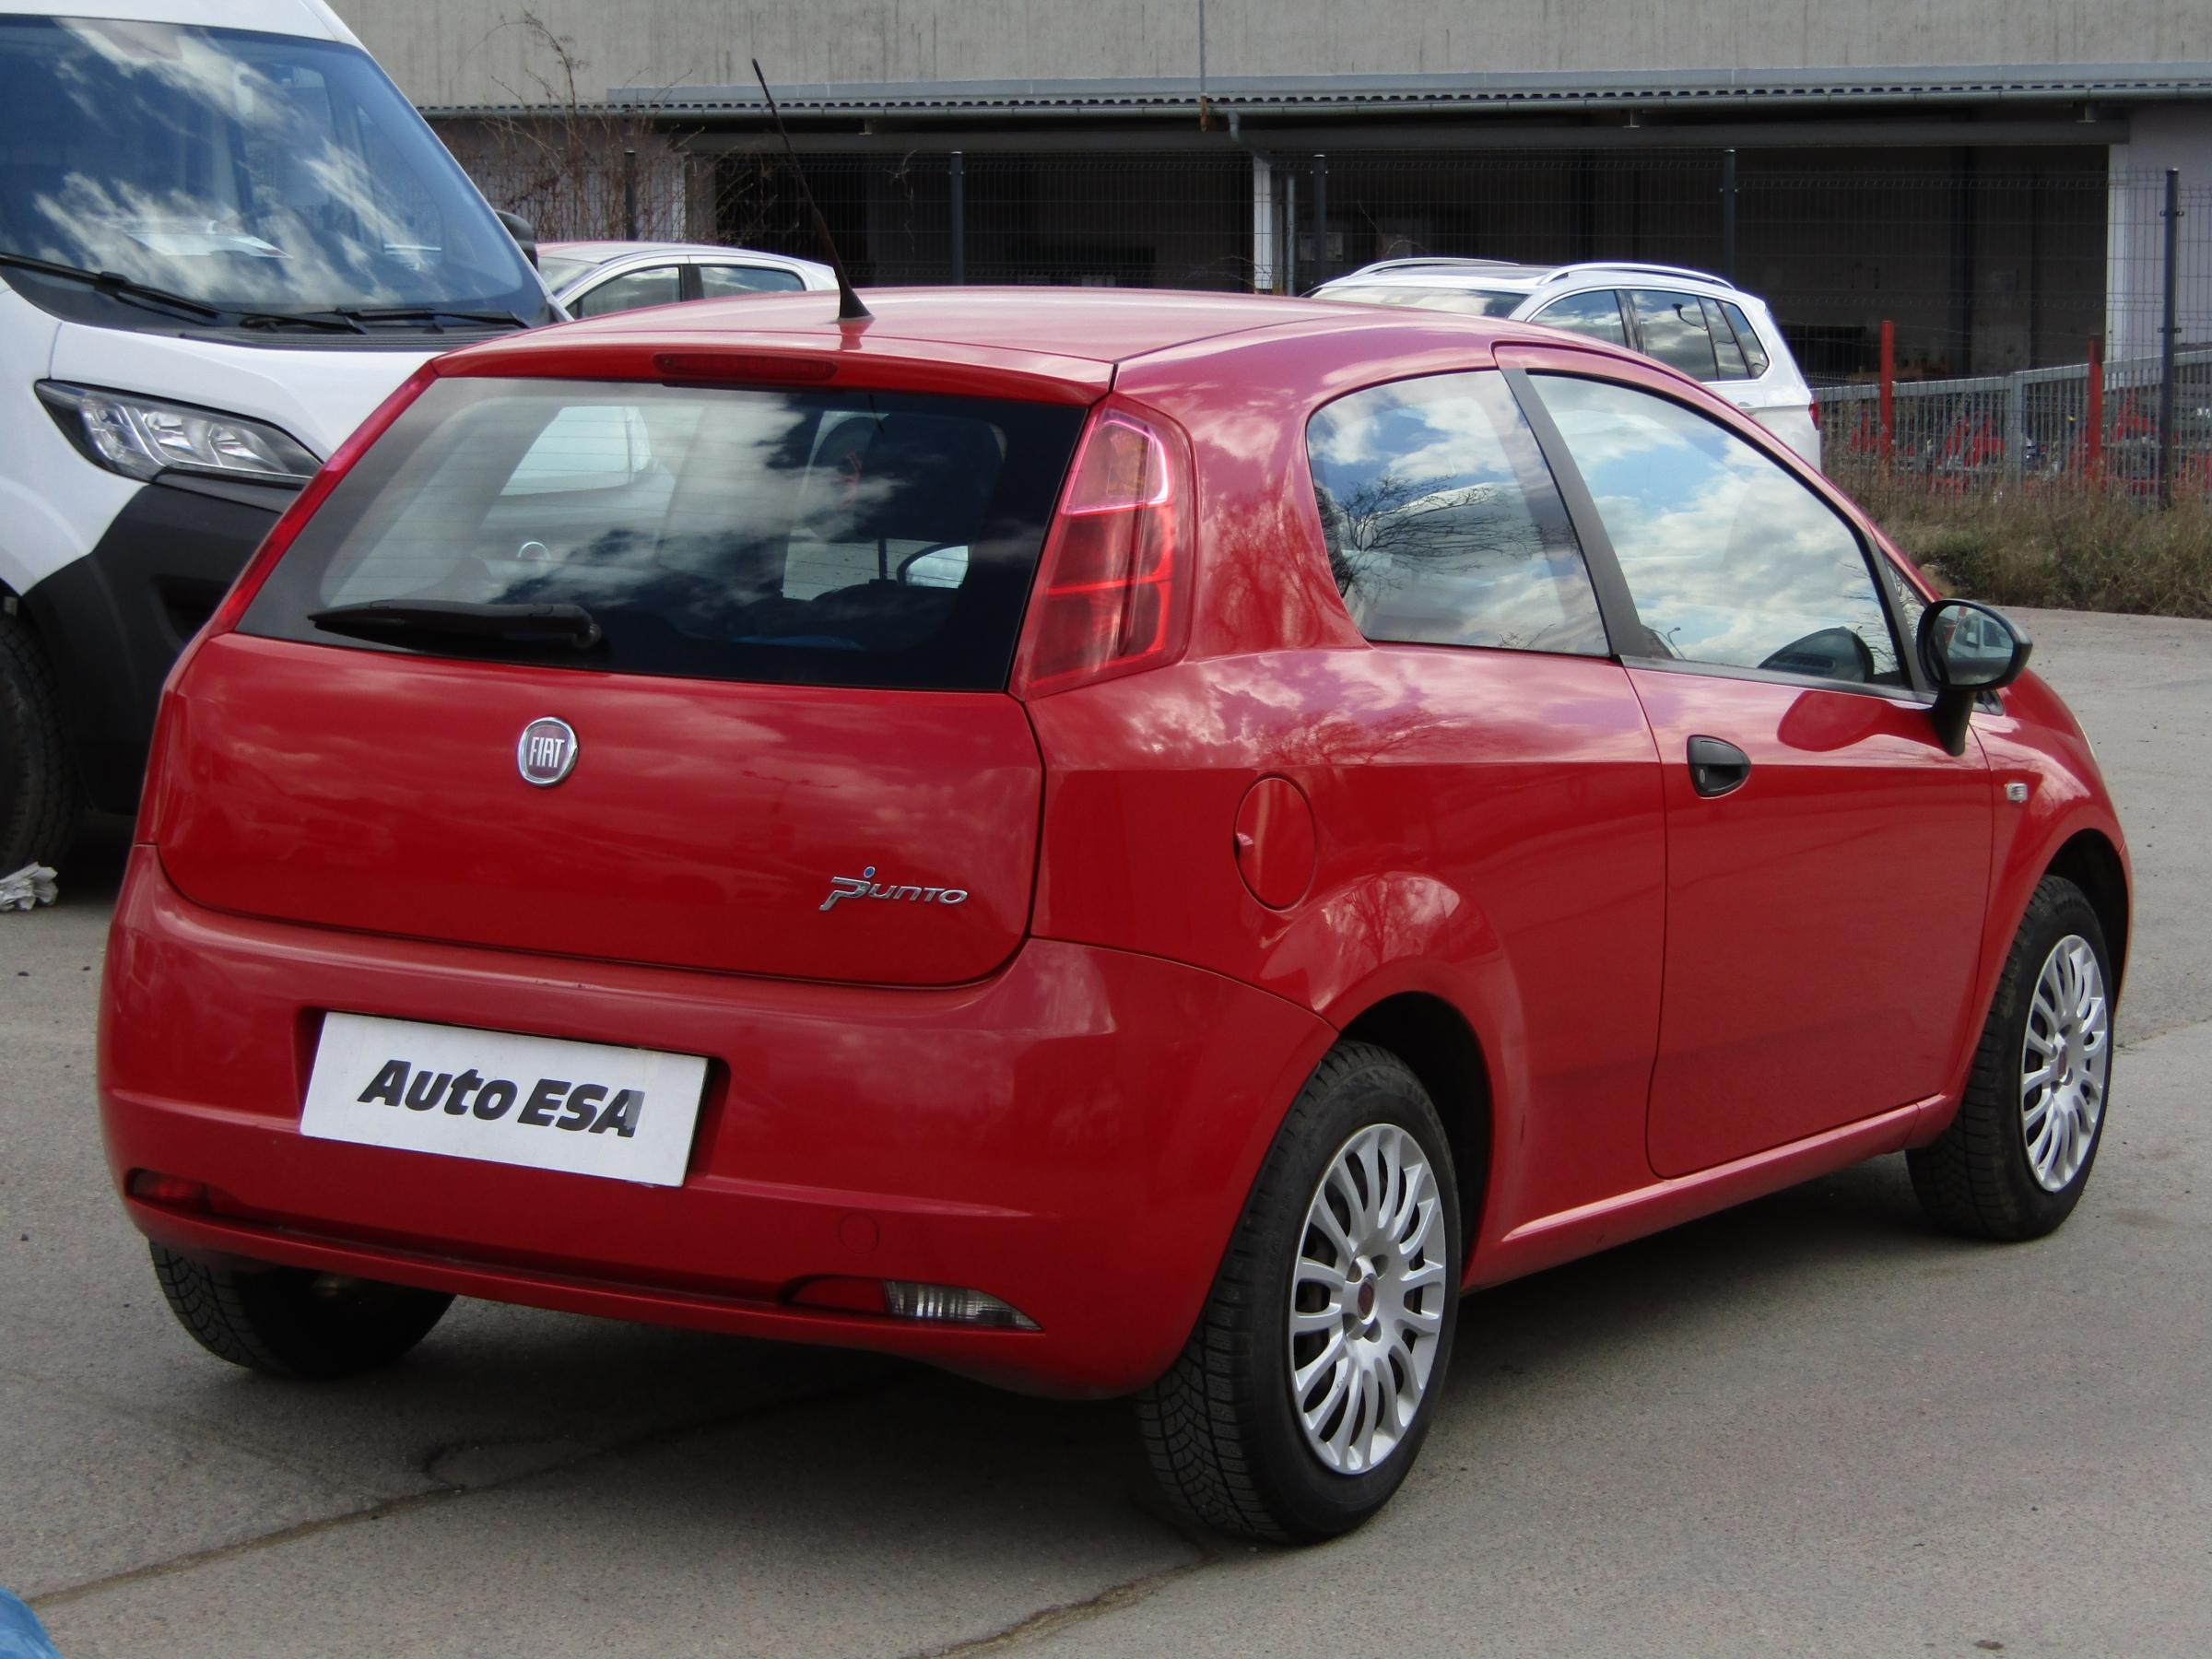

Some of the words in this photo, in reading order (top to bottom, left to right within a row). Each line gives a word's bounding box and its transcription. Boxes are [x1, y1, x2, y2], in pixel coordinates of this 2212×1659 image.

[528, 736, 566, 769] FIAT
[357, 1059, 518, 1121] Auto
[516, 1078, 646, 1138] ESA
